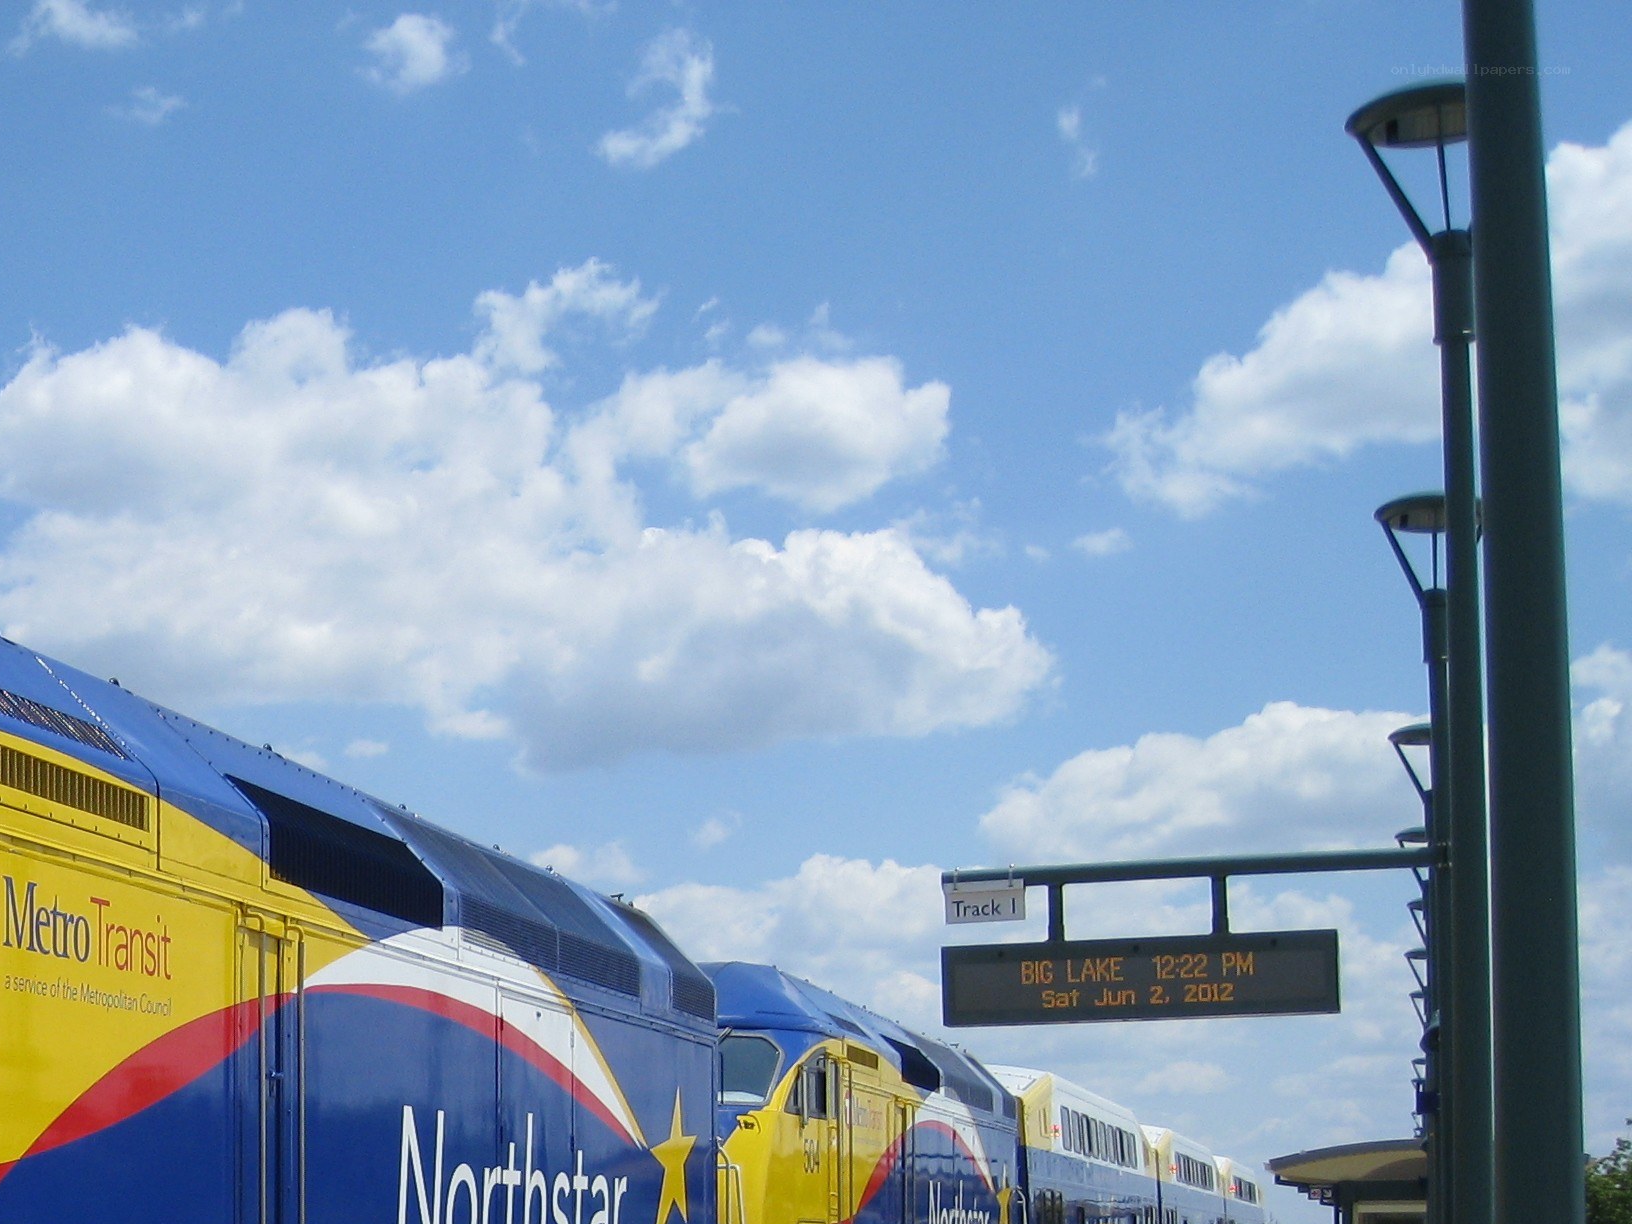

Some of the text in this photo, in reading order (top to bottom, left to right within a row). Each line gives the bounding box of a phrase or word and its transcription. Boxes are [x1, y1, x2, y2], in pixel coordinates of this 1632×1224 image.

[951, 899, 1001, 919] Track
[2, 875, 172, 981] Metro Transit
[1020, 951, 1255, 985] BIG LAKE 12:22 PM
[4, 975, 172, 1016] a service of the Metropolitan Council
[1041, 982, 1235, 1009] Sat Jun 2, 2012
